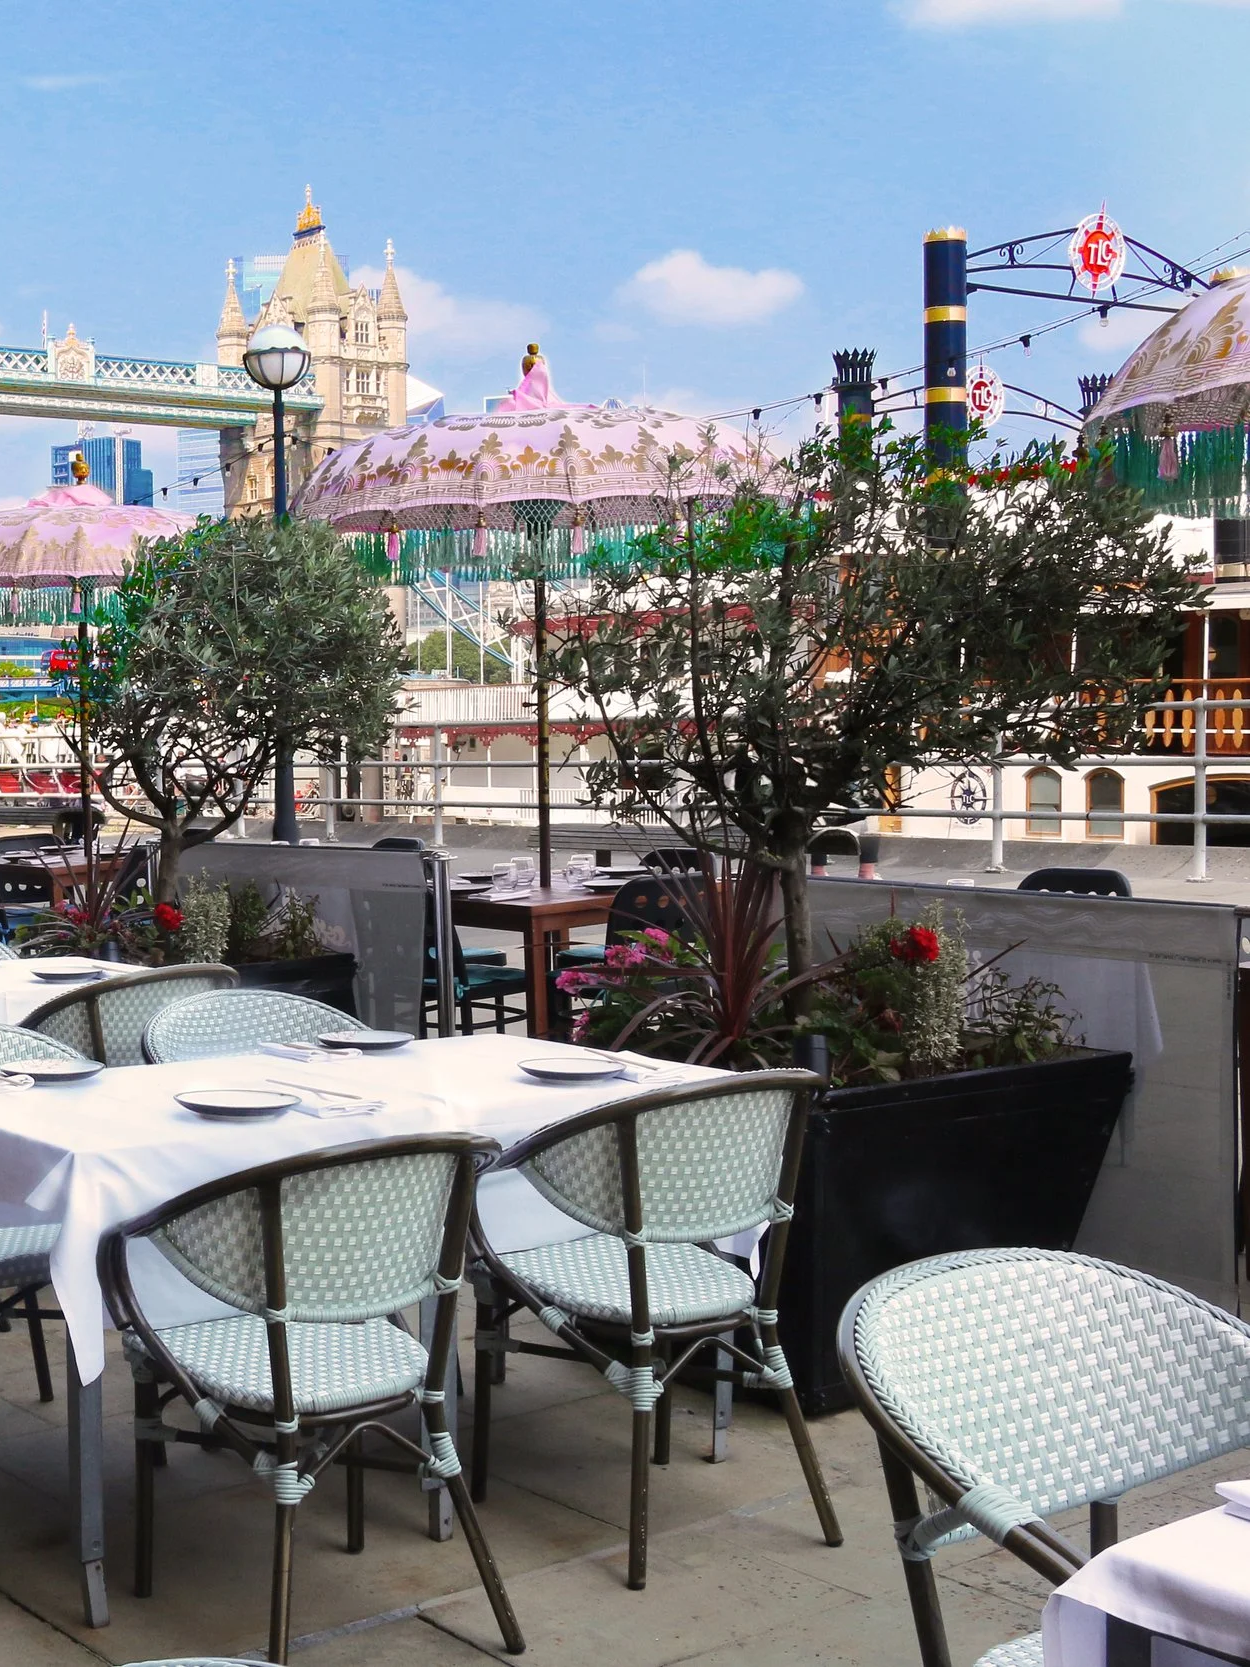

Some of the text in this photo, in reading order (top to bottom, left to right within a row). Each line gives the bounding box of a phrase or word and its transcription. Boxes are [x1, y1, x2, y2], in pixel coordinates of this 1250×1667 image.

[1087, 239, 1113, 266] TLC
[972, 386, 992, 407] TLC
[962, 794, 975, 804] TLC
